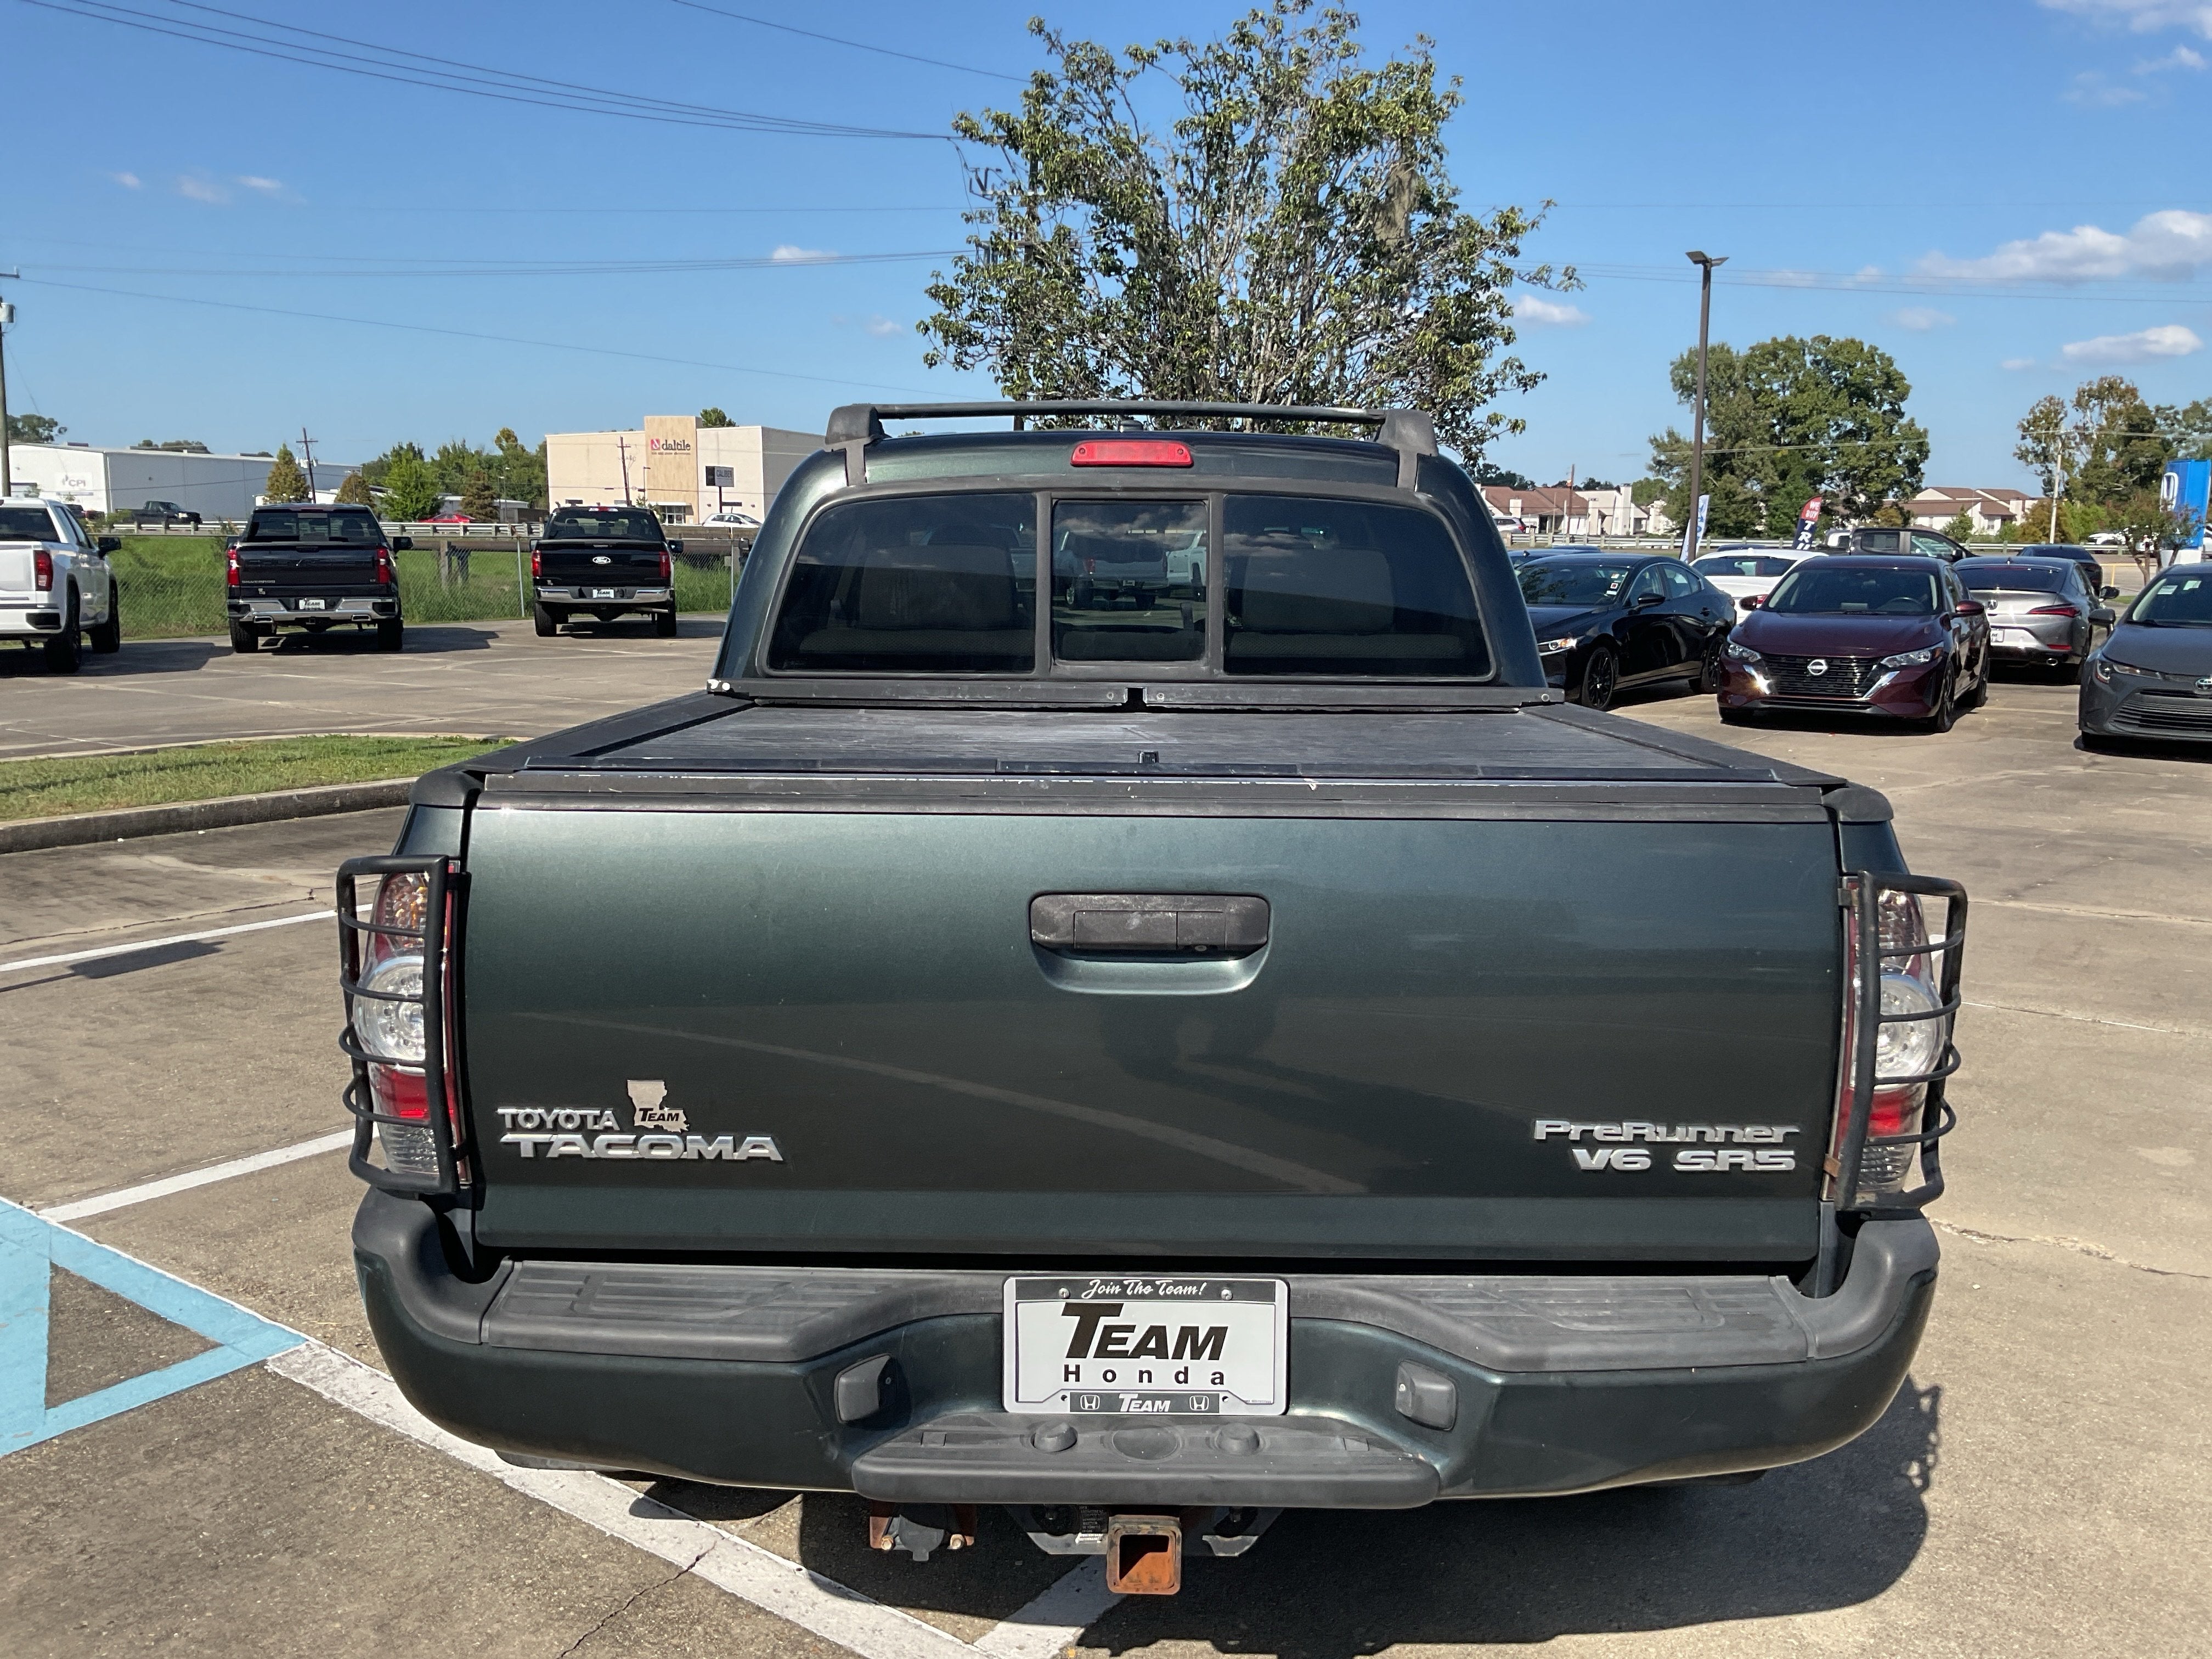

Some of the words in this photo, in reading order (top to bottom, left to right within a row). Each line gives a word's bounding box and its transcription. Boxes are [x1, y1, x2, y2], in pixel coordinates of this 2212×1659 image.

[662, 439, 691, 450] daltile
[1805, 510, 1819, 518] BUY
[496, 1107, 620, 1130] TOYOTA
[639, 1108, 679, 1121] TEAM
[1534, 1120, 1801, 1142] PreRunner
[500, 1133, 783, 1161] TACOMA
[1572, 1149, 1651, 1170] V6
[1673, 1149, 1796, 1171] SR5
[1081, 1279, 1121, 1299] Join
[1124, 1279, 1153, 1295] The
[1155, 1280, 1207, 1296] Team!
[1061, 1302, 1228, 1361] TEAM
[1064, 1364, 1224, 1385] Honda
[1119, 1393, 1171, 1412] TEAM
